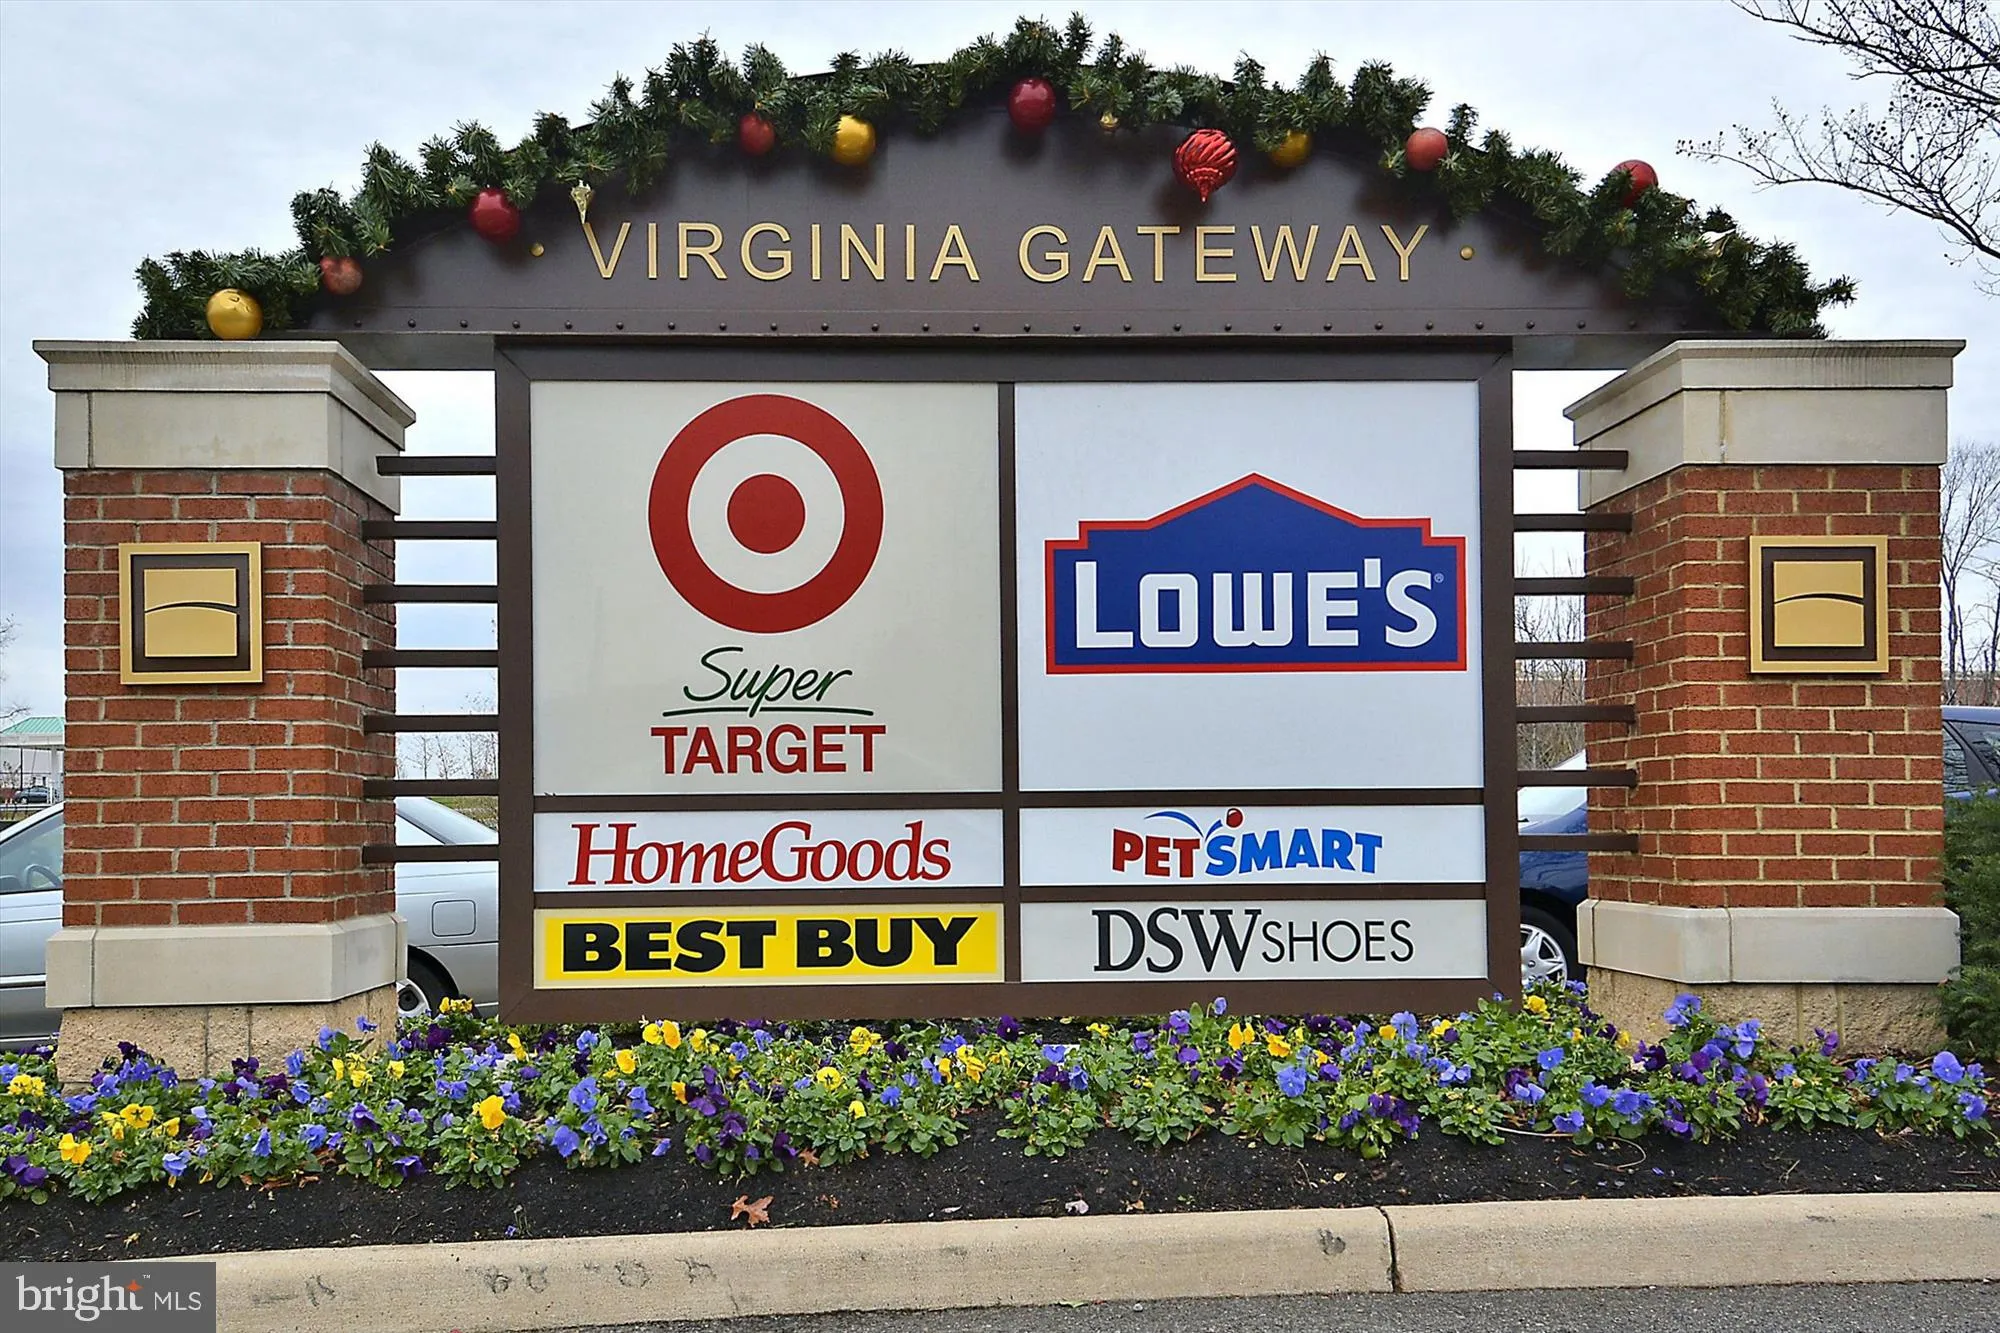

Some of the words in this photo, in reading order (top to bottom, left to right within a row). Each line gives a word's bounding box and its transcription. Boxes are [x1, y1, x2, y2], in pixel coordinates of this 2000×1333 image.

[584, 222, 980, 281] VIRGINIA
[1017, 224, 1430, 283] GATEWAY
[1075, 558, 1438, 650] LOWE'S
[683, 646, 853, 717] Super
[650, 724, 887, 775] TARGET
[567, 820, 952, 886] HomeGoods
[562, 920, 778, 973] BEST
[796, 916, 979, 968] BUY
